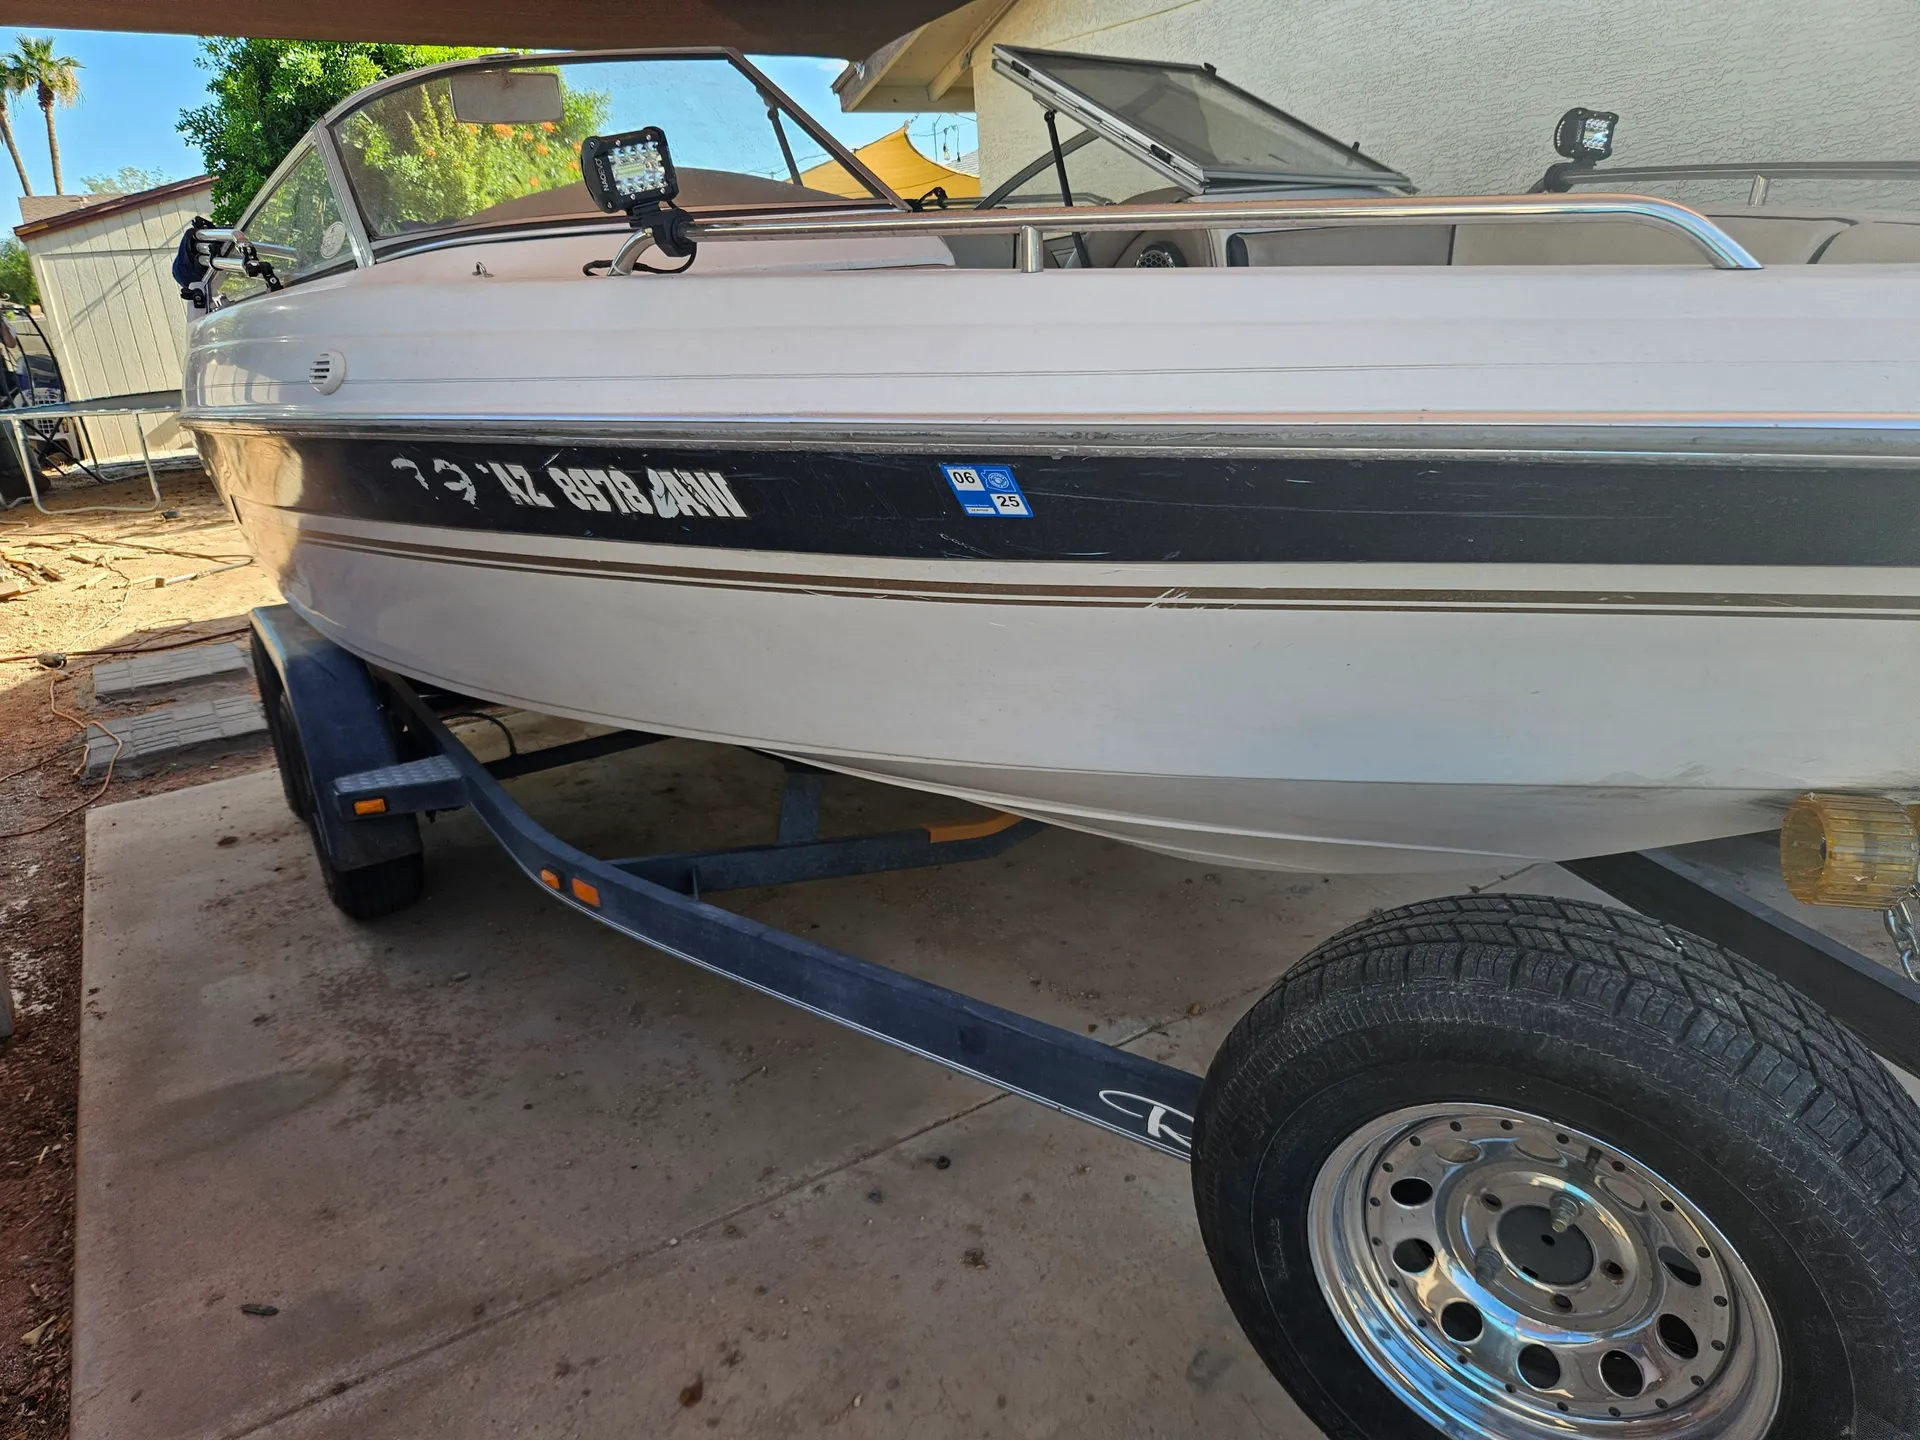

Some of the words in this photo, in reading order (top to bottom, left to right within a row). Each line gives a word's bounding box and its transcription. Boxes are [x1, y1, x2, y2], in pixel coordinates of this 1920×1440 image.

[595, 158, 609, 191] NAOEVO
[487, 462, 556, 508] AZ
[547, 467, 654, 515] 8978
[953, 472, 975, 484] 06
[997, 496, 1020, 507] 25
